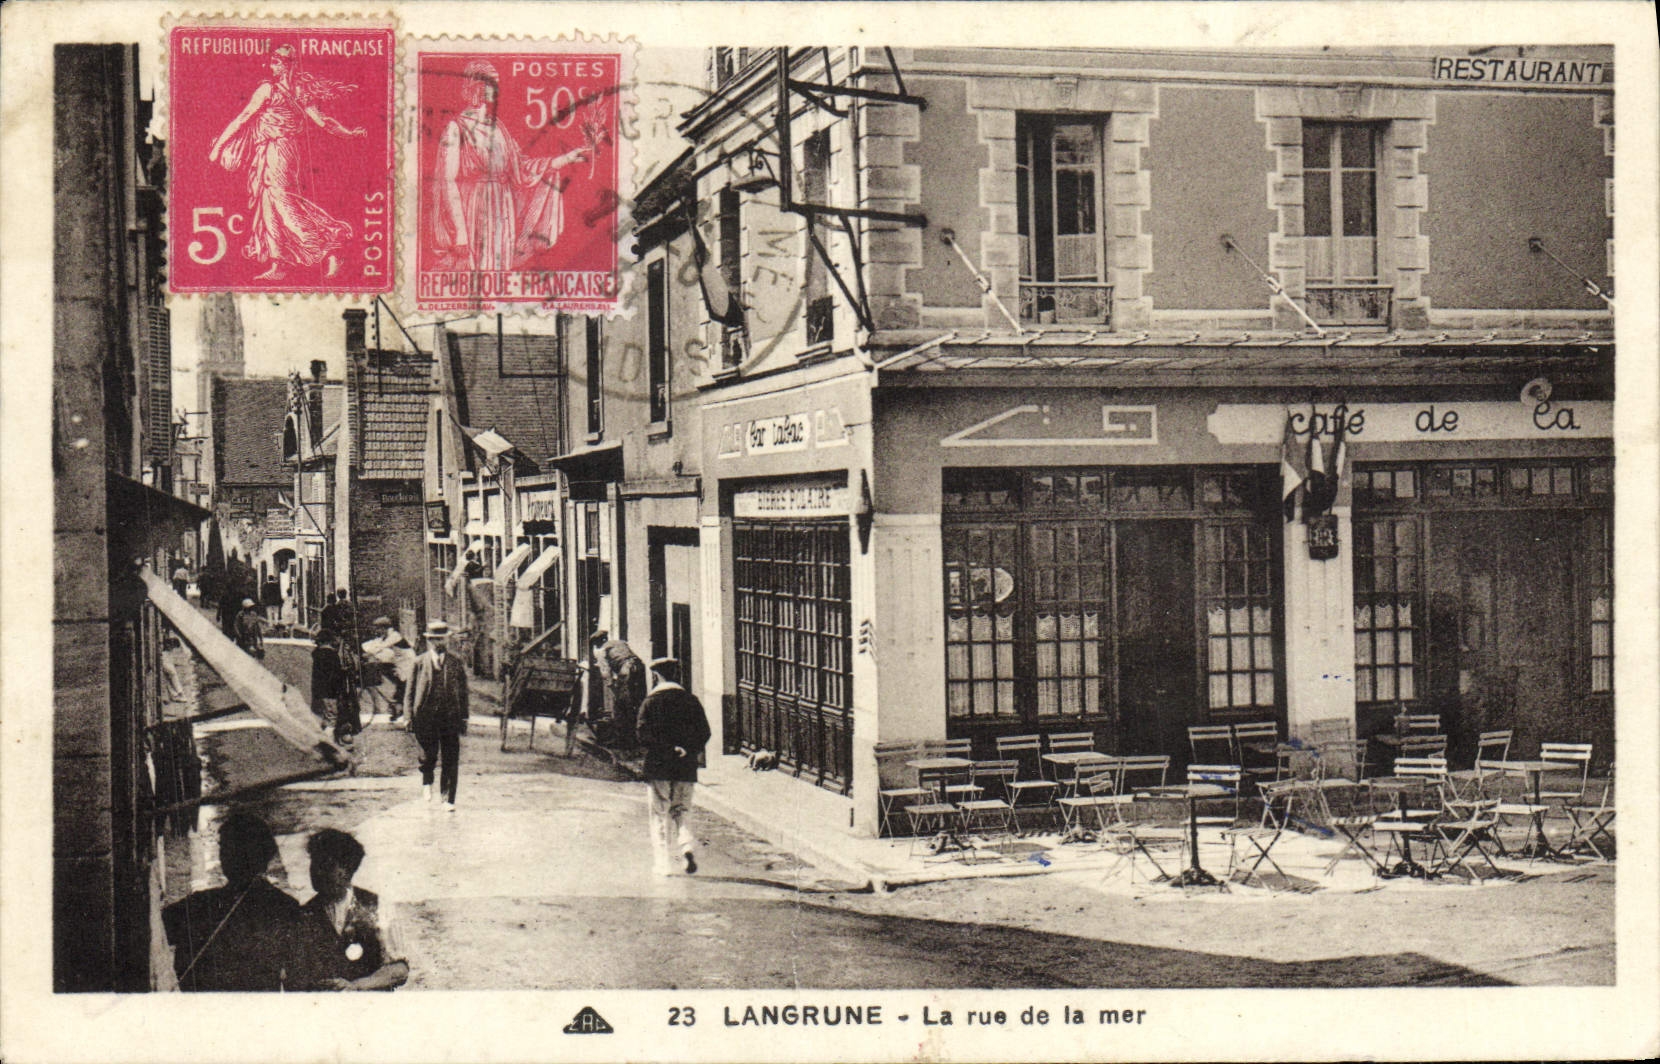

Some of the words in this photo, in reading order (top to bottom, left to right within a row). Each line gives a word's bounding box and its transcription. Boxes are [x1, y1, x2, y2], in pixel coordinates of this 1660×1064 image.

[181, 37, 271, 56] REPUBLIQUE
[301, 38, 384, 58] FRANÇAISE
[512, 61, 604, 78] POSTES
[1436, 58, 1602, 83] RESTAURANT
[364, 191, 384, 276] POSTES
[420, 273, 512, 298] REPUBLIQUE
[521, 273, 613, 298] FRANÇAISE
[1289, 404, 1365, 435] café
[1415, 405, 1459, 432] de
[1533, 400, 1581, 430] la
